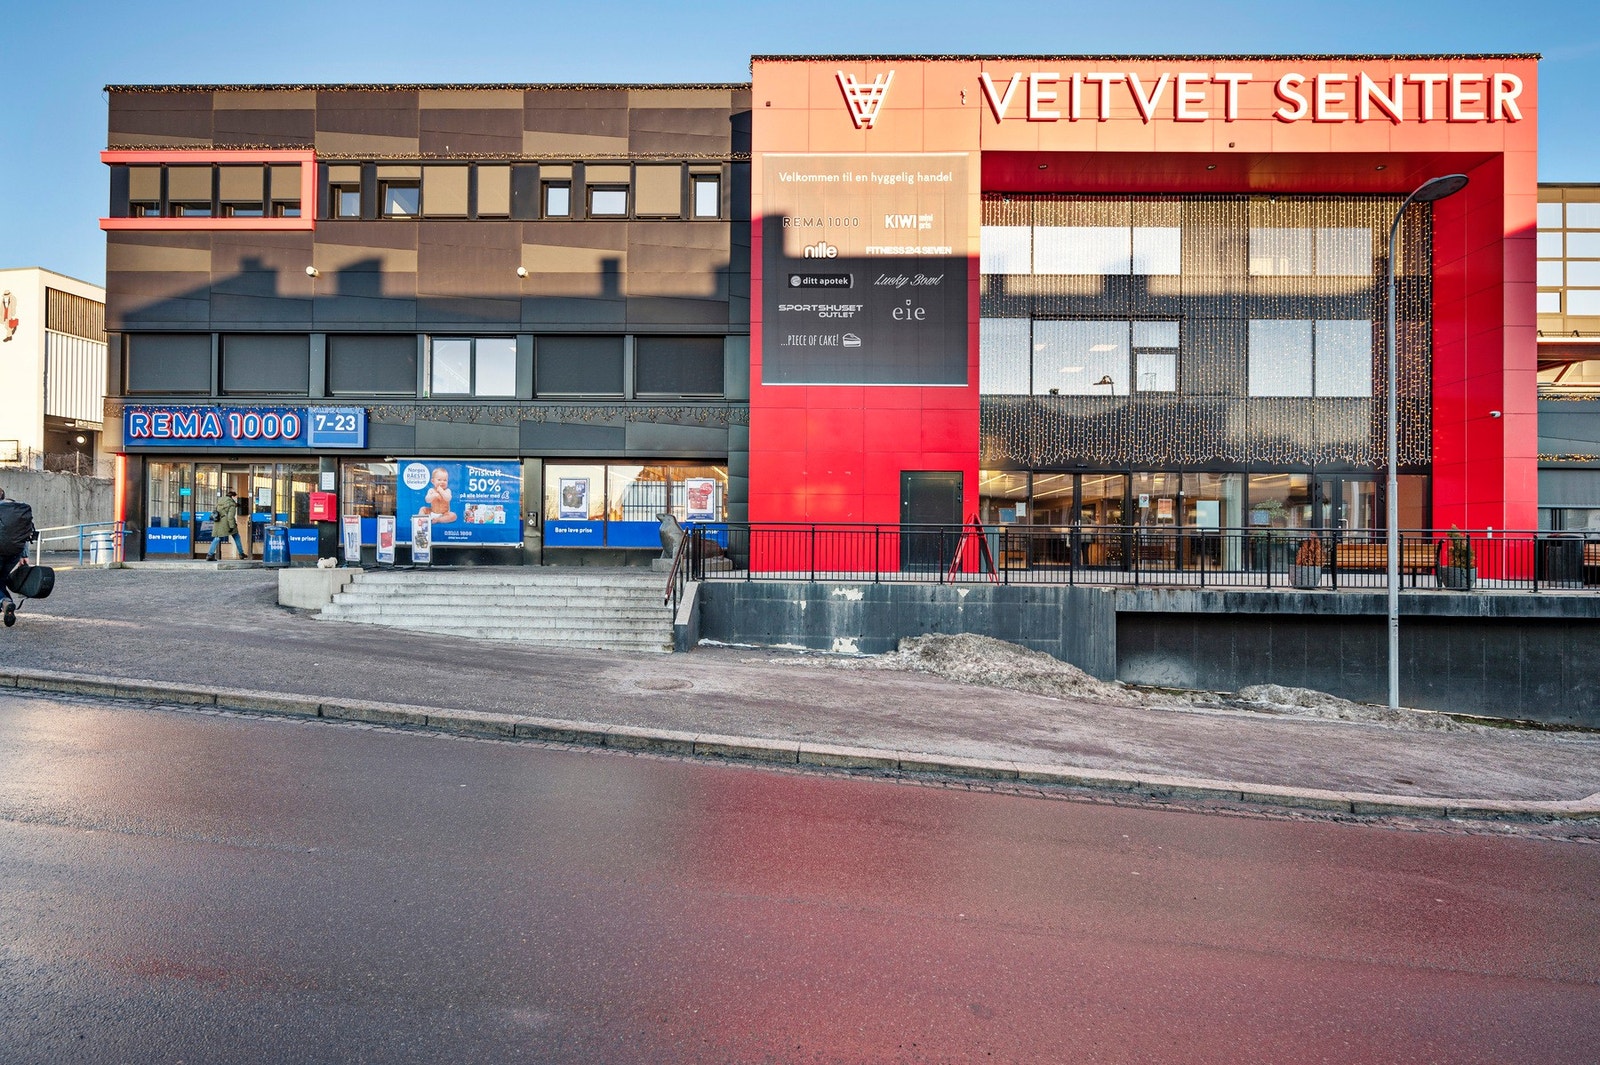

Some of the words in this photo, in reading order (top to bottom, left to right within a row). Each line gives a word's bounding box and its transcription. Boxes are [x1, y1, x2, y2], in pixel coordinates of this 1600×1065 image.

[978, 71, 1254, 125] VEITVET
[1272, 71, 1524, 125] SENTER
[779, 172, 840, 182] Velkommen
[842, 172, 853, 182] til
[855, 174, 868, 182] en
[871, 172, 914, 185] hyggelig
[917, 172, 953, 182] handel
[783, 217, 824, 227] REMA
[828, 217, 859, 227] 1000
[884, 214, 917, 229] KIWI
[804, 241, 838, 259] nille
[802, 277, 818, 285] ditt
[819, 277, 849, 287] apotek
[874, 273, 909, 289] Lucky
[910, 273, 945, 286] Bowl
[778, 304, 864, 312] SPORTSHUSET
[892, 299, 926, 321] eie
[808, 334, 818, 346] OF
[819, 333, 839, 346] CAKE!
[129, 412, 223, 439] REMA
[229, 412, 300, 439] 1000
[316, 414, 356, 431] 7-23
[468, 478, 501, 492] 50%
